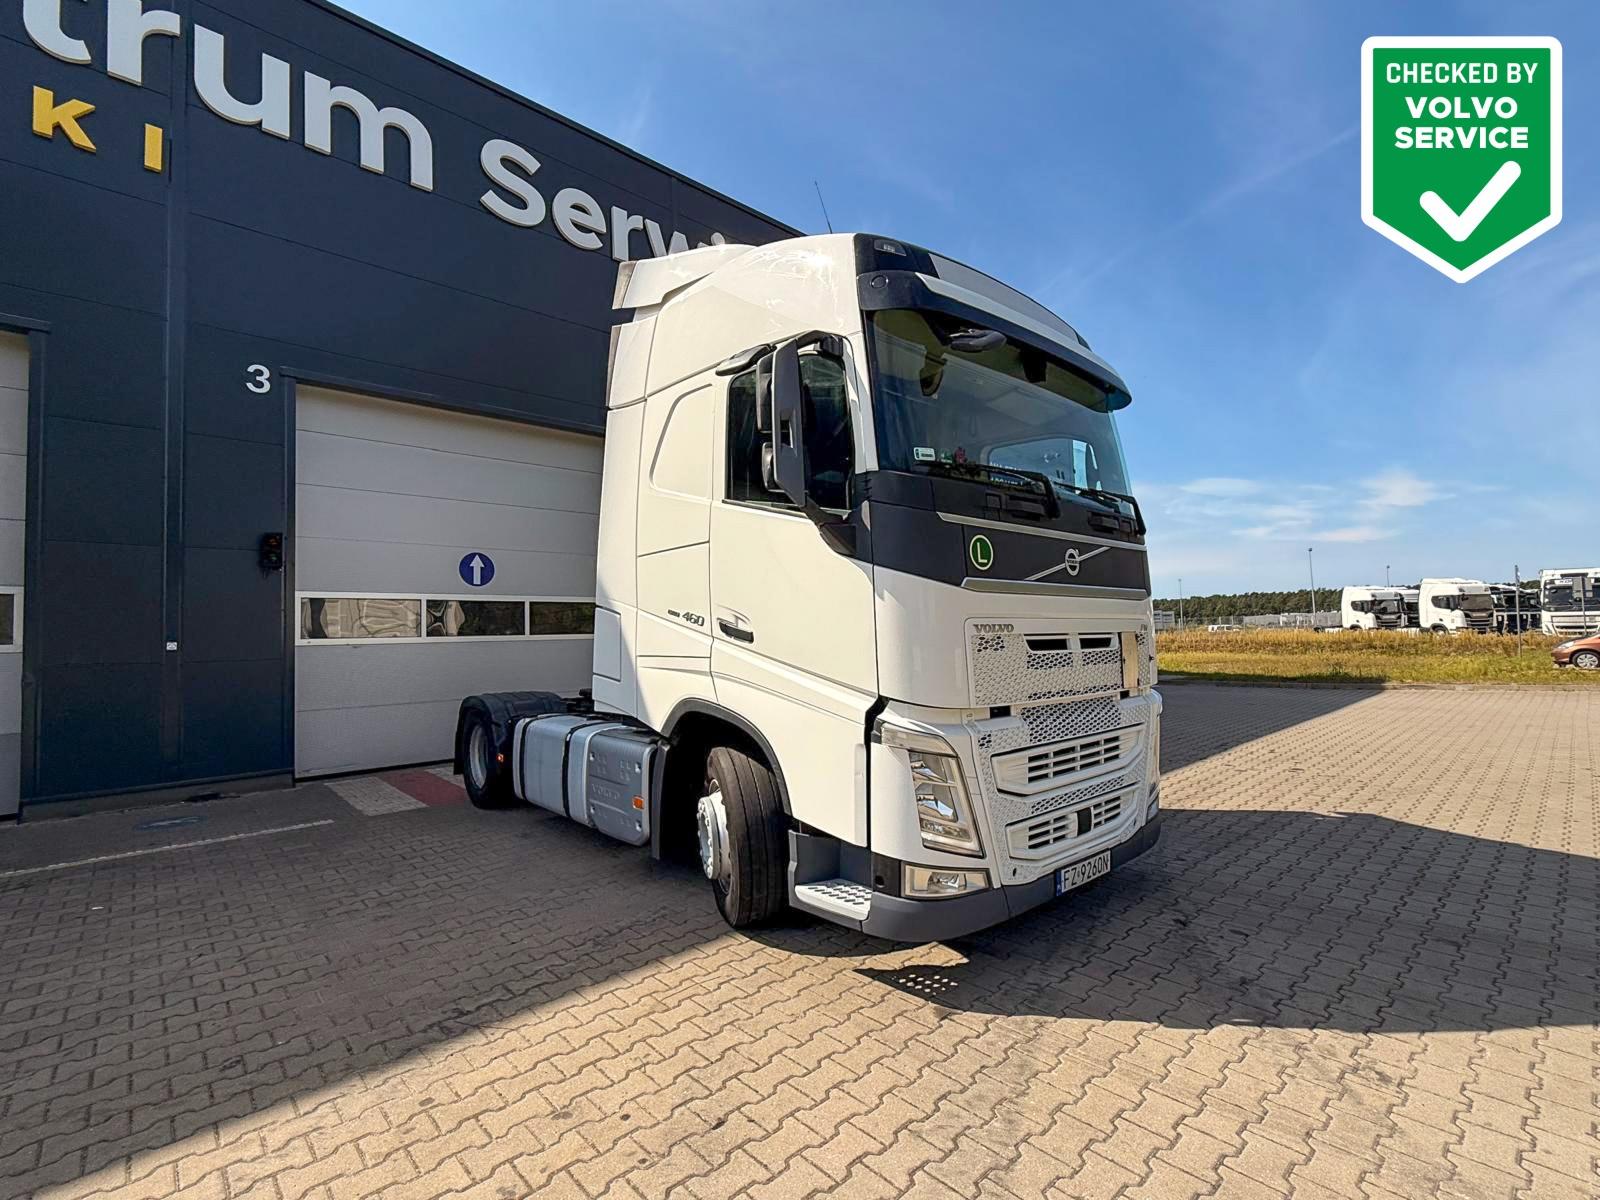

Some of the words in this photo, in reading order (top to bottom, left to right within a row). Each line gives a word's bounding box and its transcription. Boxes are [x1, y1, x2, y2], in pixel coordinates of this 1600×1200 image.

[245, 364, 271, 394] 3
[976, 541, 988, 564] L
[682, 611, 705, 627] 460
[973, 623, 1015, 634] VOLVO
